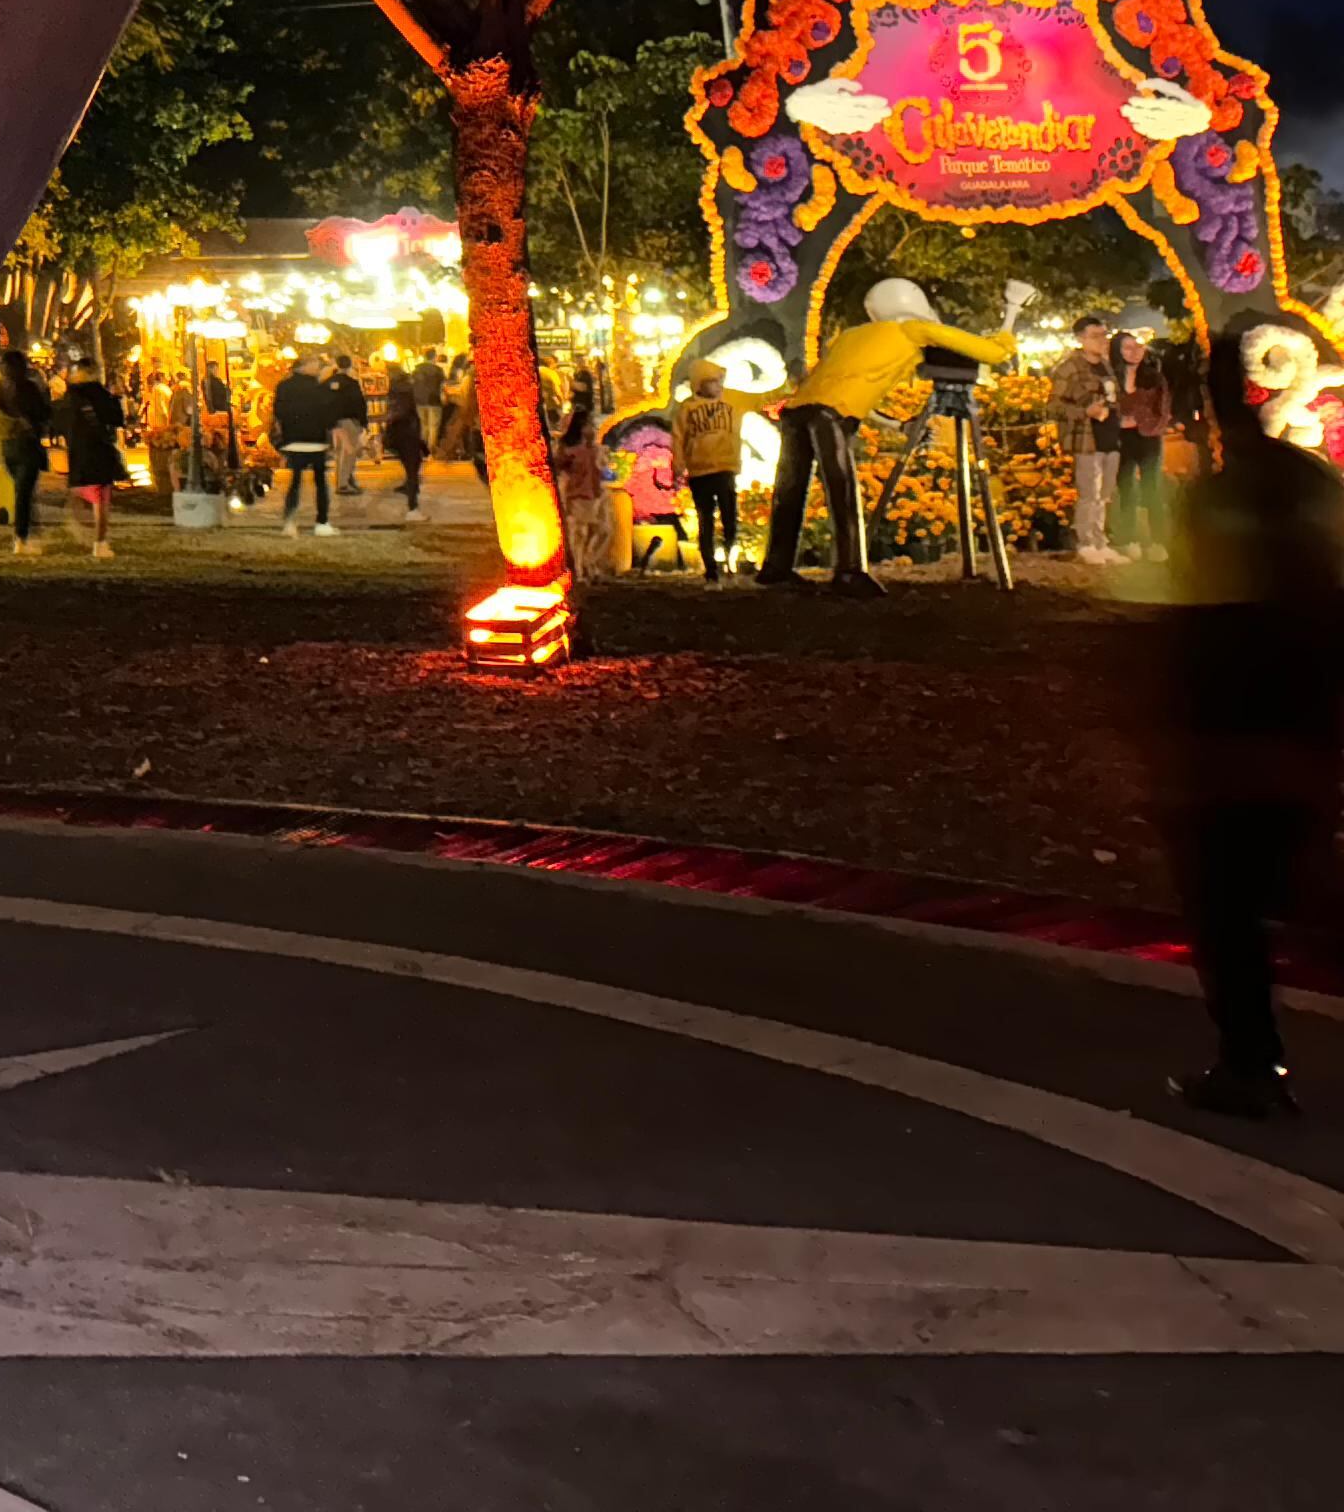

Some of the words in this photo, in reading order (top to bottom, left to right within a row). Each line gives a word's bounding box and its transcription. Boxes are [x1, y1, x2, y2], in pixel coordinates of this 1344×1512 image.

[957, 21, 1004, 82] 5
[940, 156, 988, 177] Parque
[959, 180, 1030, 190] GUADALAJARA
